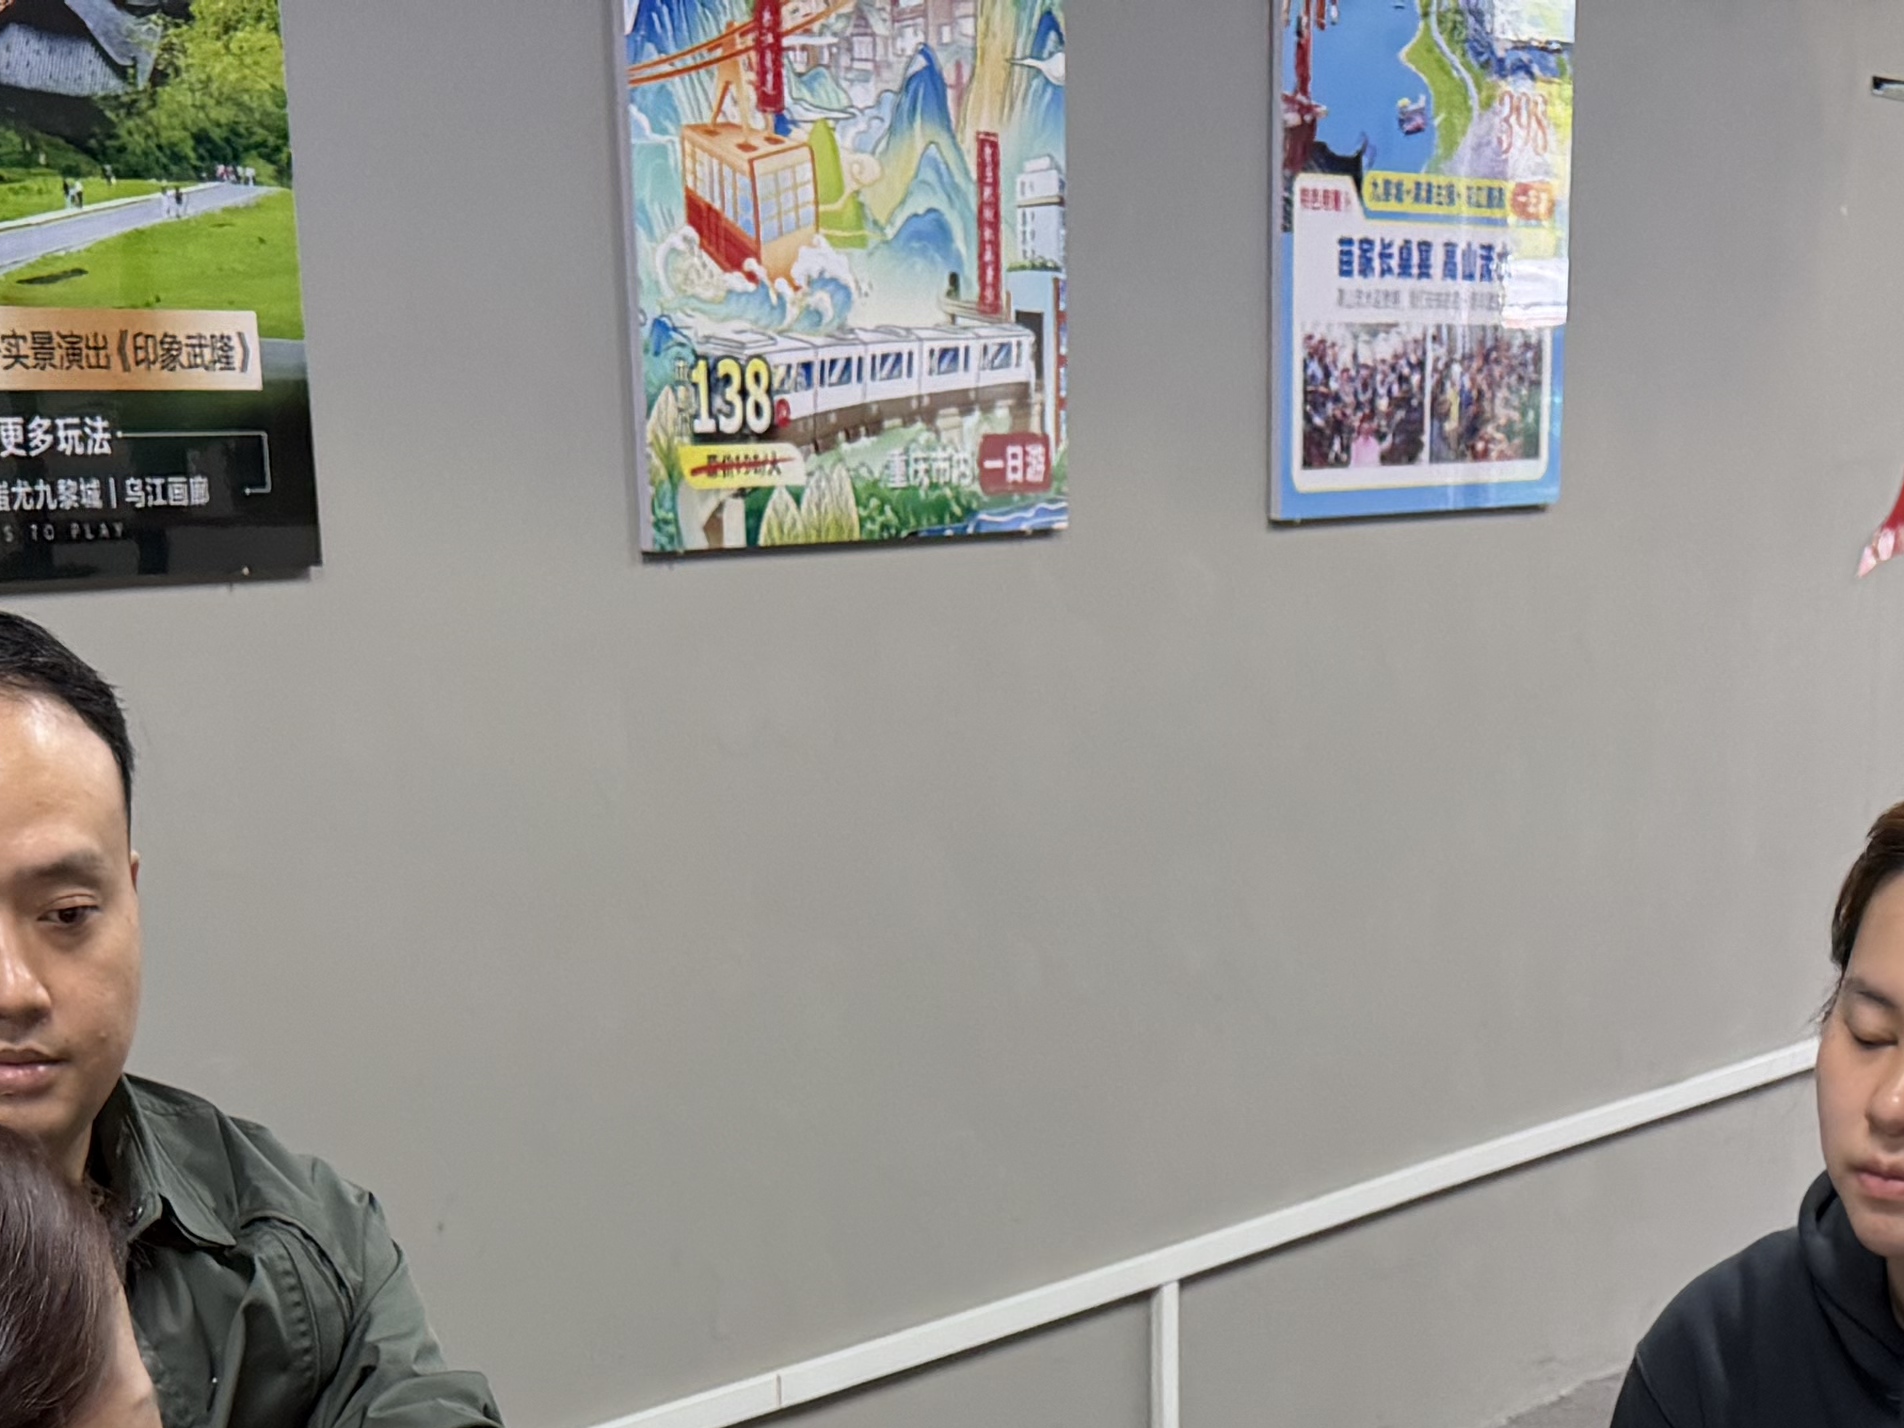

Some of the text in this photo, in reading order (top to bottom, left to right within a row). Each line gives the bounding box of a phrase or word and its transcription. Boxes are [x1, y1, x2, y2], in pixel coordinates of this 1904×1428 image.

[1497, 91, 1549, 156] 398
[690, 357, 773, 434] 138
[31, 523, 55, 541] TO
[70, 521, 124, 540] PLAY
